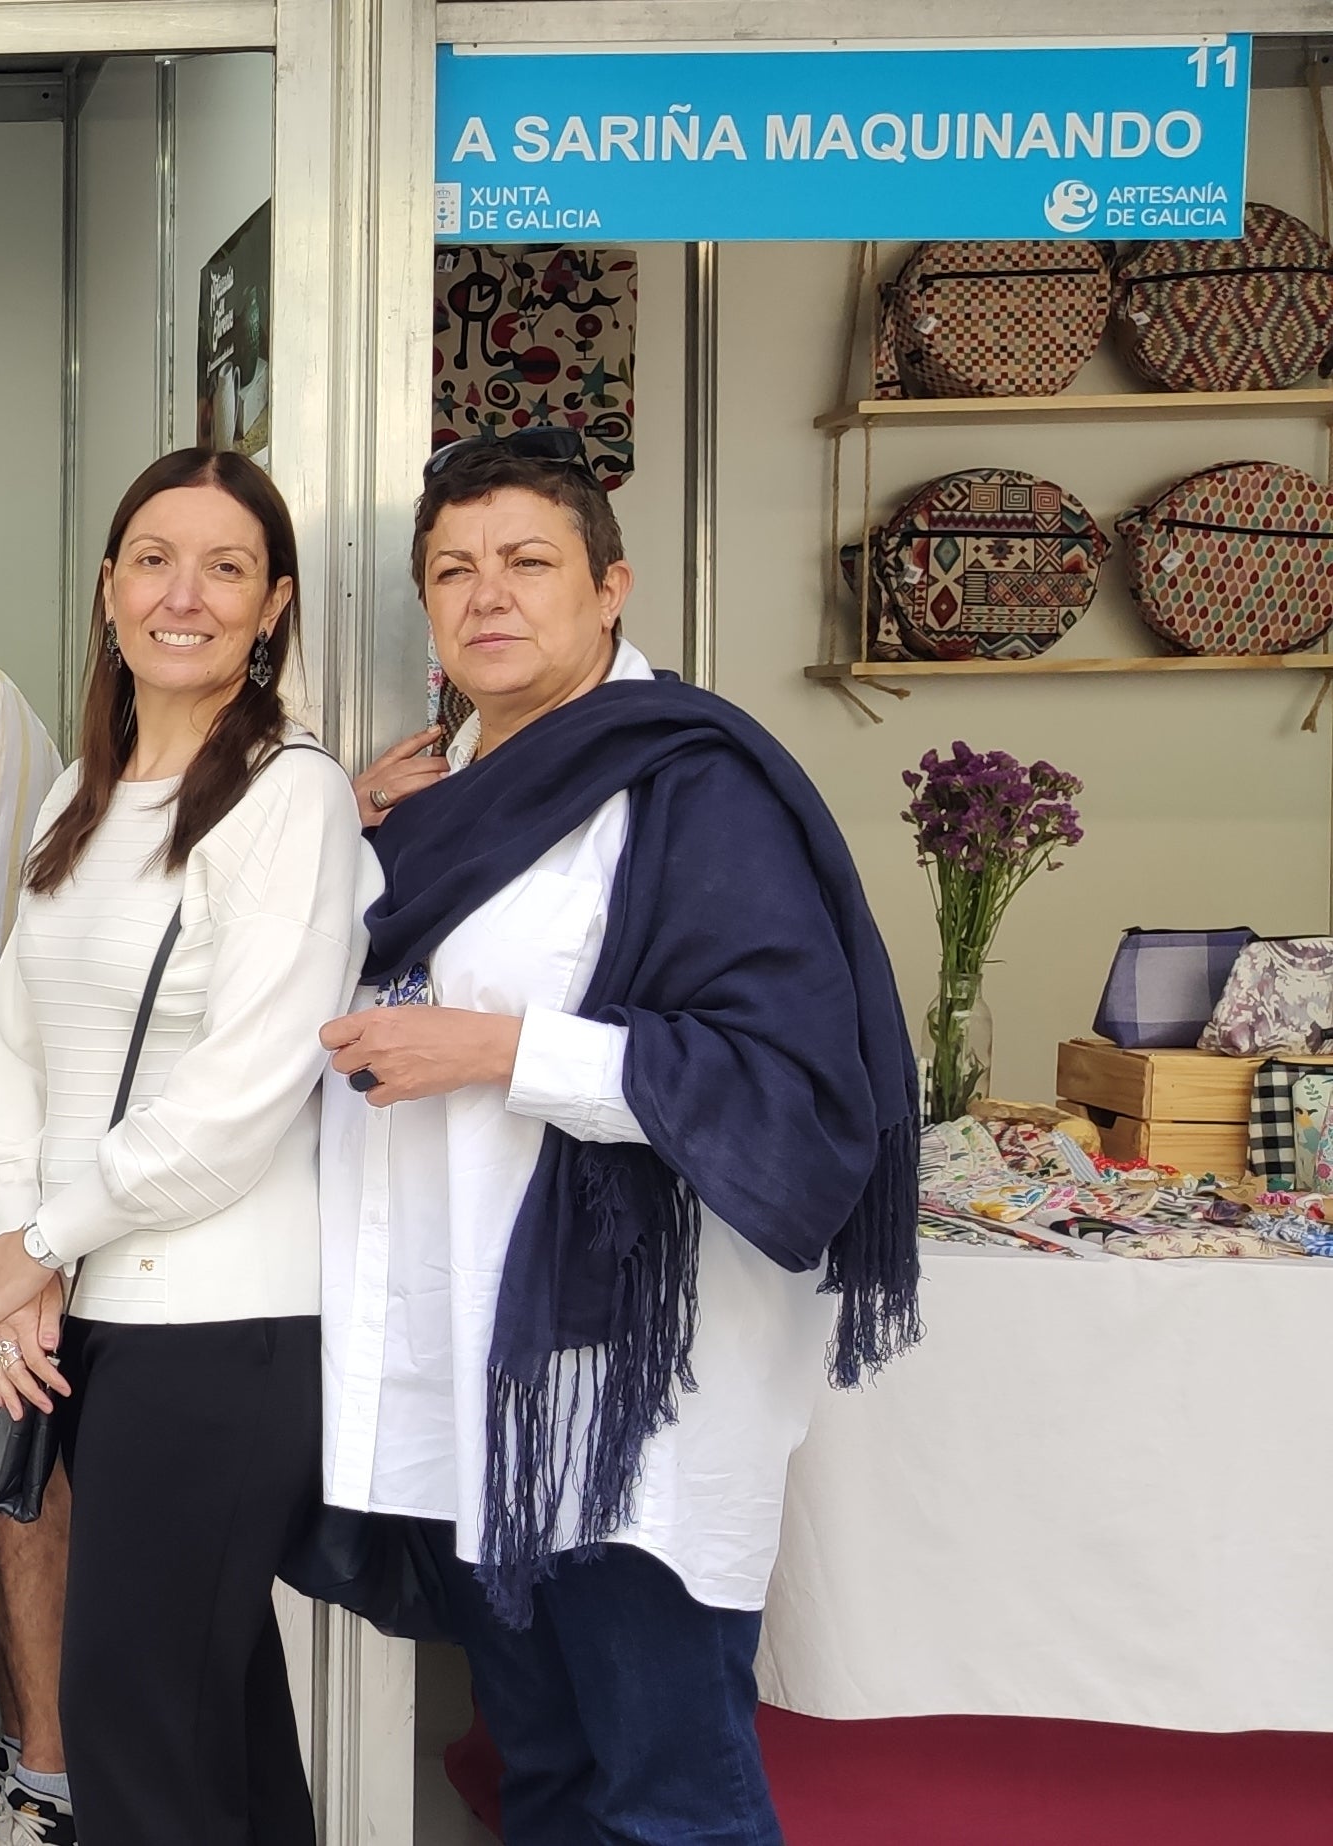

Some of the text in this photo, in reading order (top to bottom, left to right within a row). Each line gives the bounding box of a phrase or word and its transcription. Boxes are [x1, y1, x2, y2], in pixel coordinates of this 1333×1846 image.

[1188, 47, 1237, 89] 11
[451, 103, 1203, 164] A SARIÑA MAQUINANDO
[469, 186, 551, 207] XUNTA
[1106, 181, 1228, 204] ARTESANÍA
[469, 209, 602, 230] DE GALICIA
[1106, 208, 1227, 226] DE GALICIA
